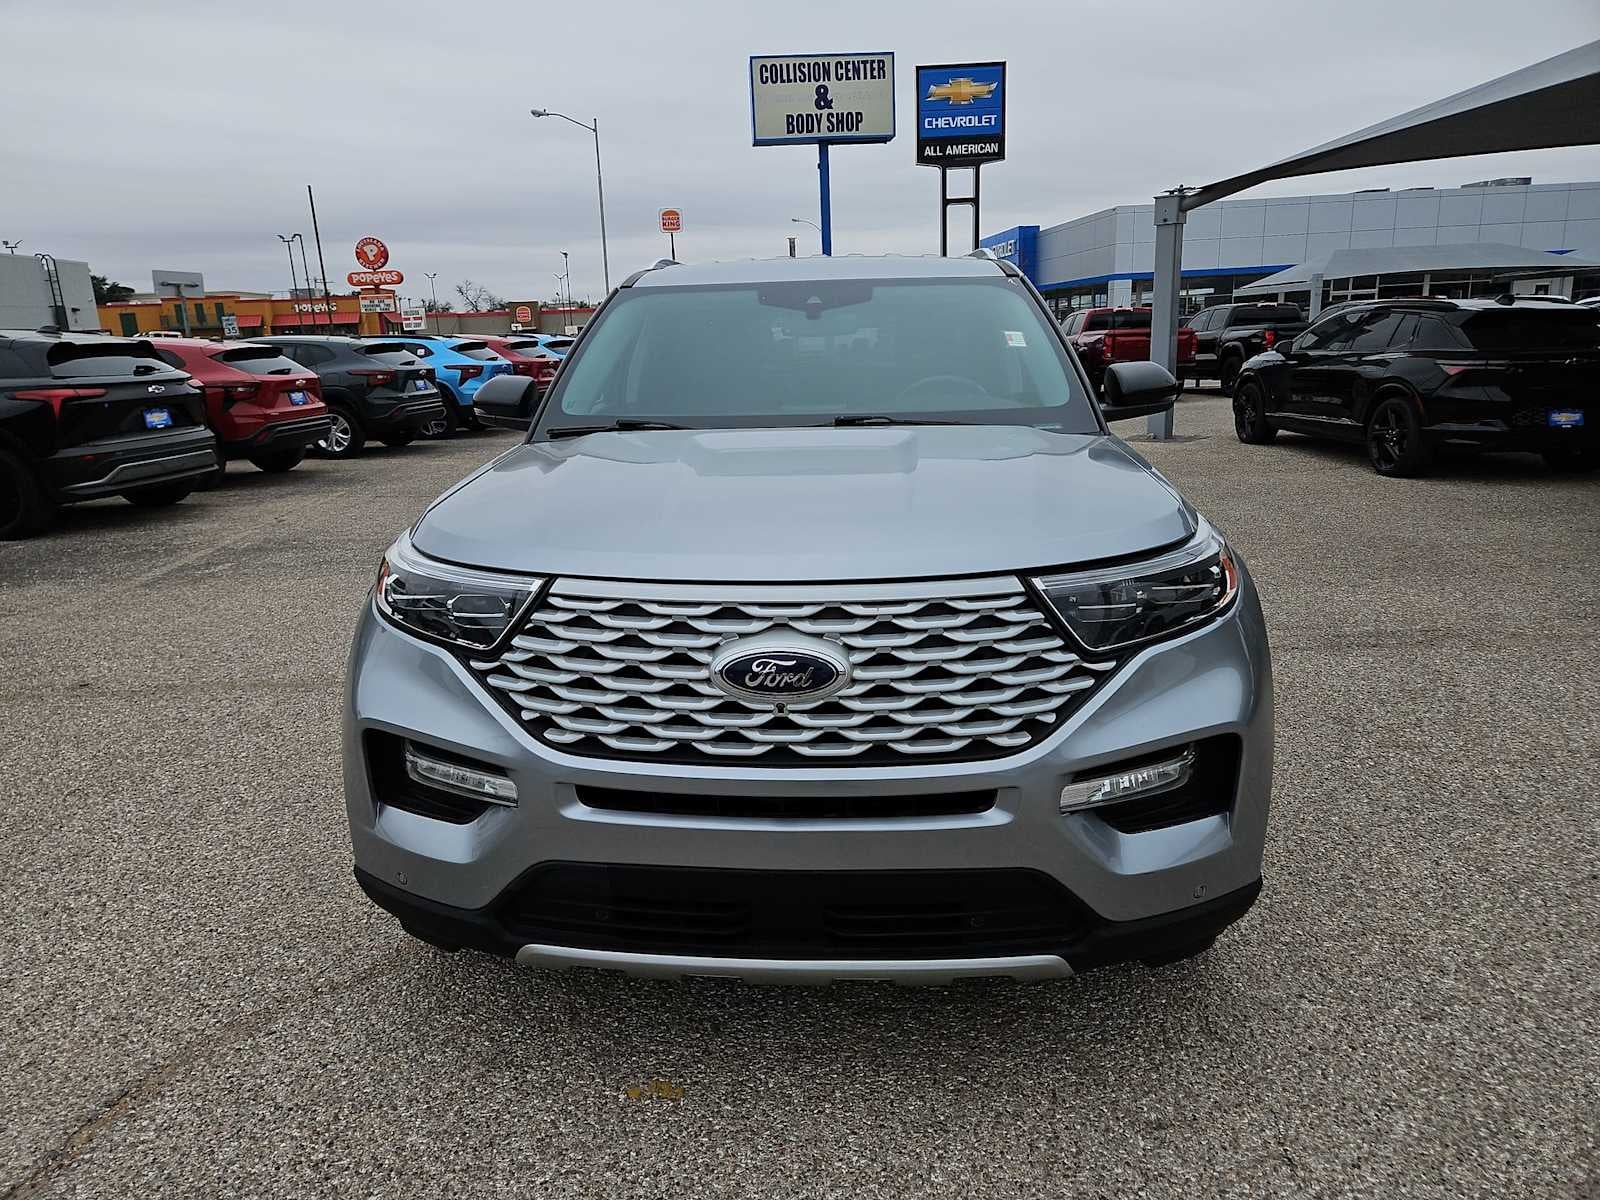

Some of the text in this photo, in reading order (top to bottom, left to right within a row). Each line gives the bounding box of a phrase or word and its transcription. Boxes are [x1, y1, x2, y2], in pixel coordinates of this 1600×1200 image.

[759, 59, 886, 85] COLLISION CENTER
[814, 84, 834, 111] &
[785, 111, 864, 135] BODY SHOP
[924, 114, 998, 129] CHEVROLET
[924, 142, 999, 156] ALL AMERICAN
[745, 658, 814, 688] Ford
